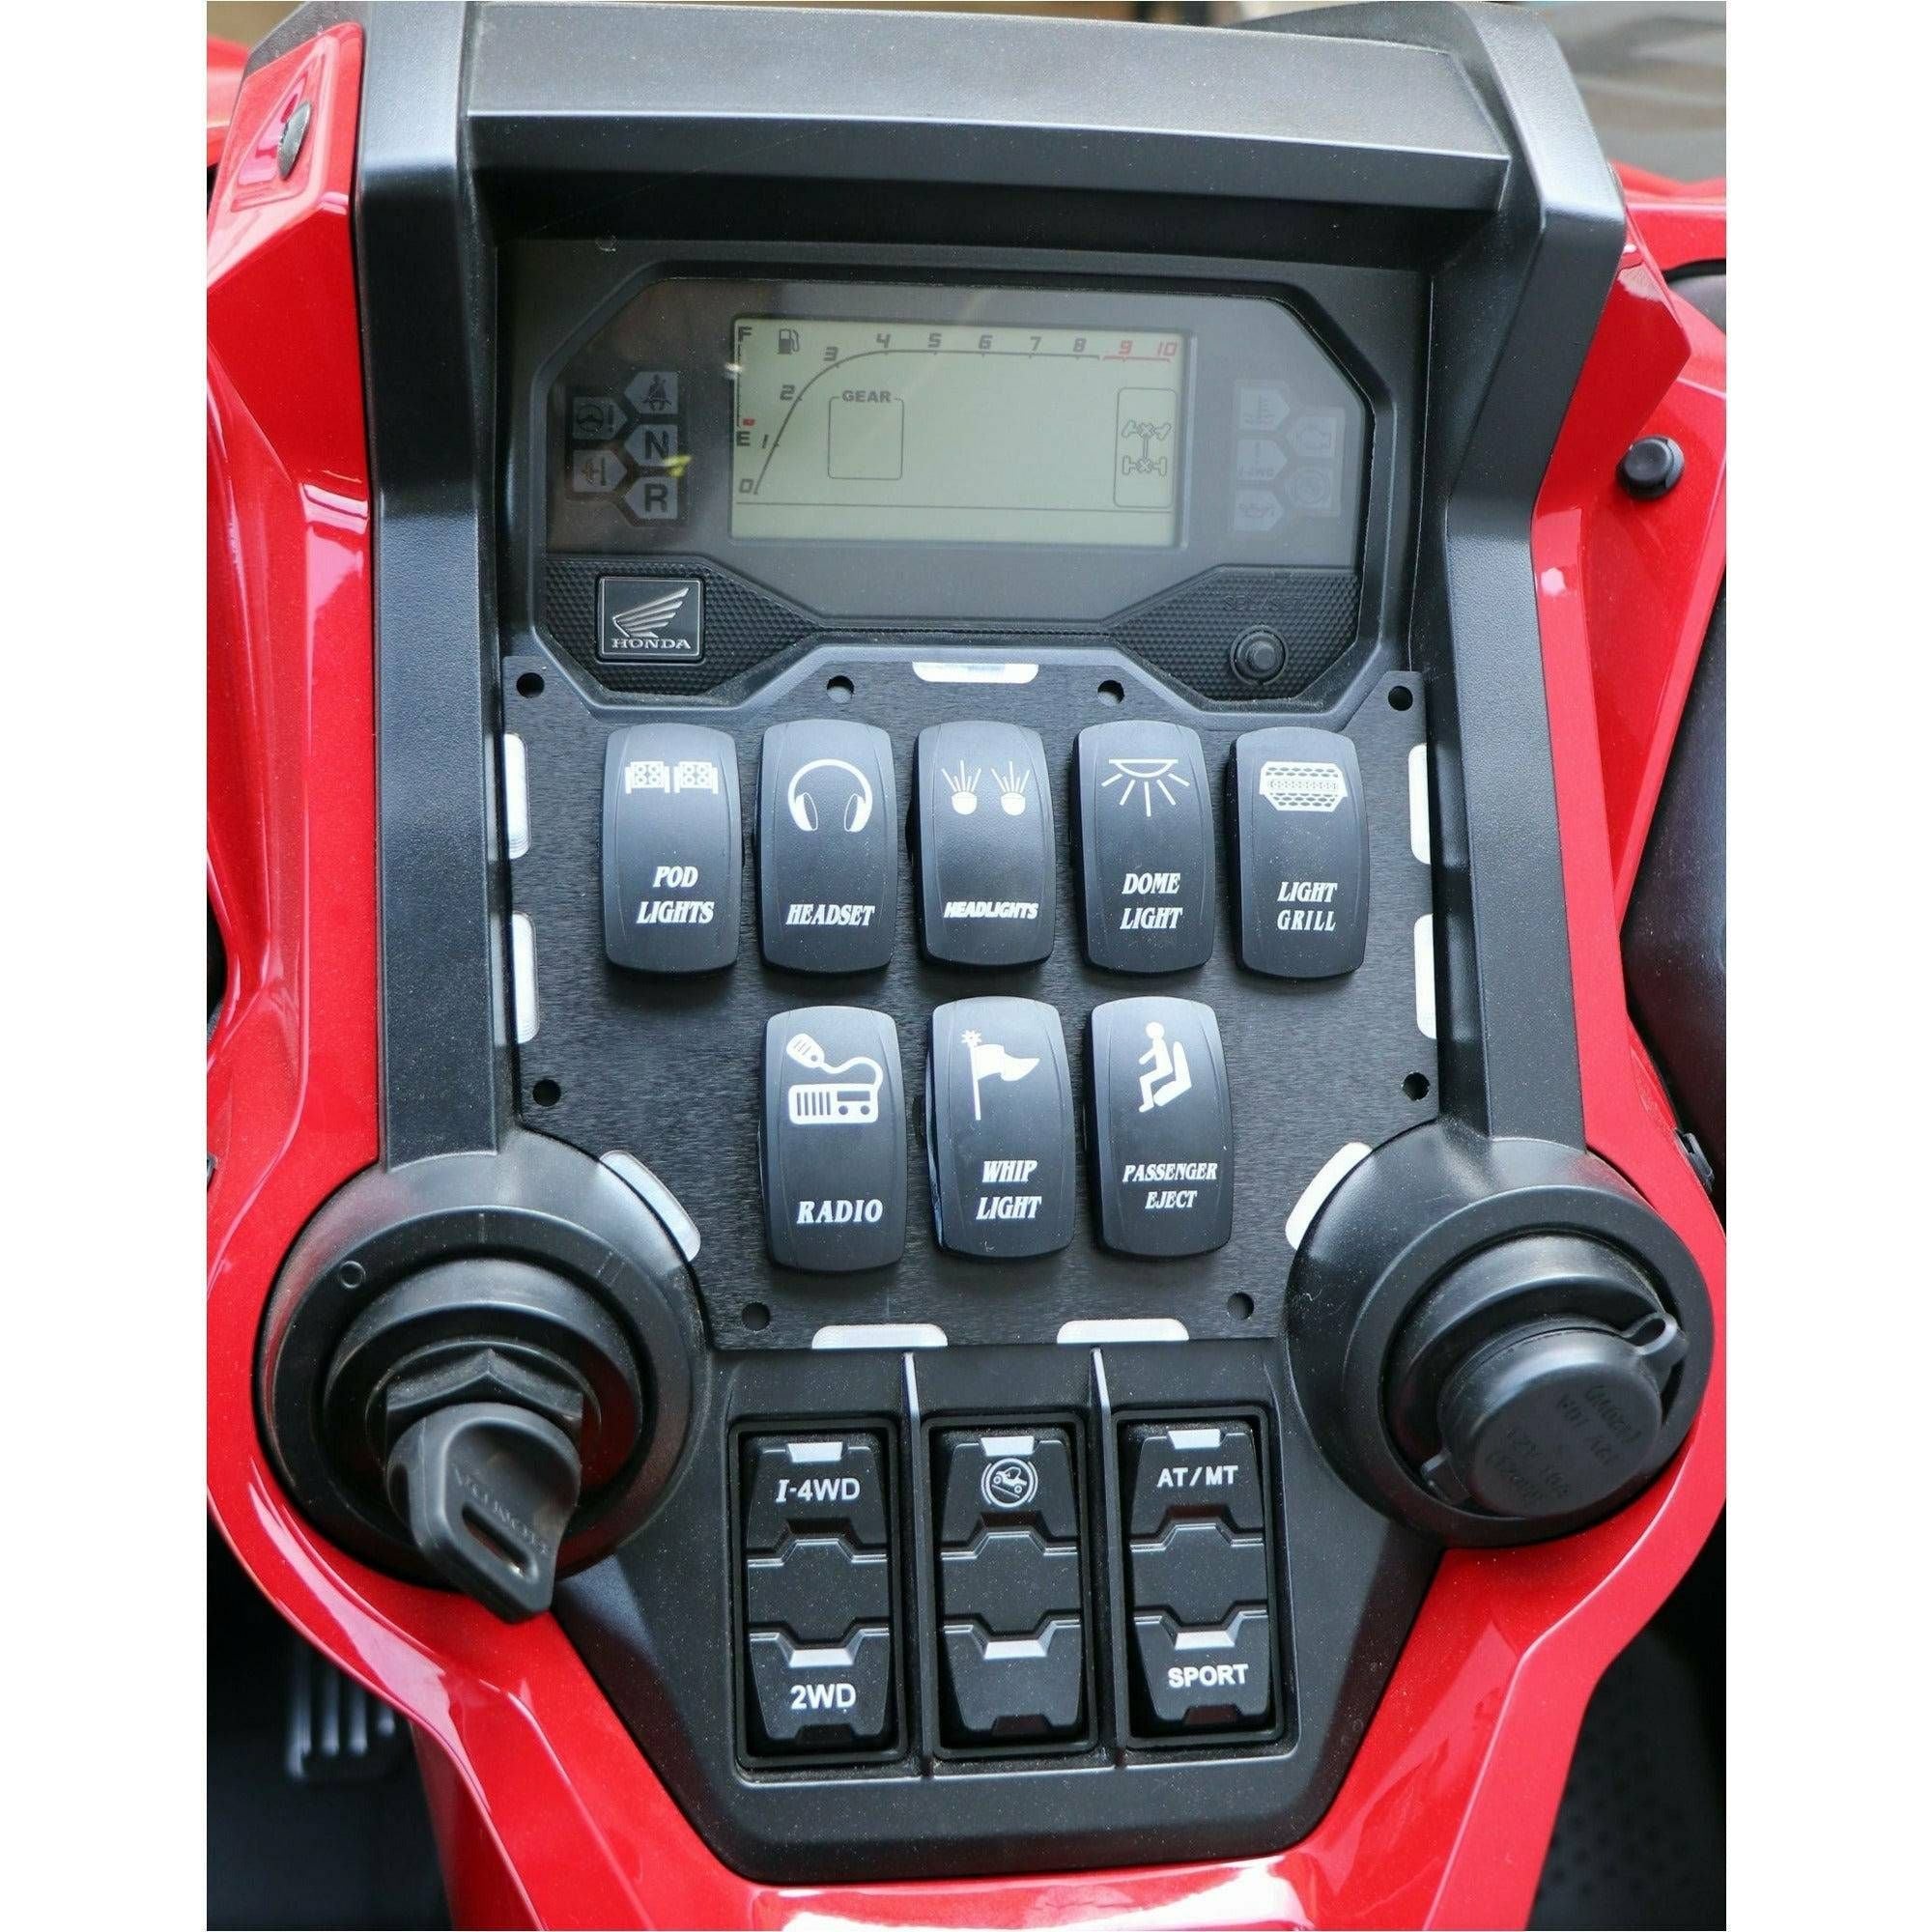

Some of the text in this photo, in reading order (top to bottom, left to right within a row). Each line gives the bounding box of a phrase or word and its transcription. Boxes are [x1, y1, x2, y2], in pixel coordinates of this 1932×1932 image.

[737, 327, 752, 342] F
[875, 333, 891, 349] 4
[928, 332, 943, 349] 5
[979, 334, 993, 351] 6
[1030, 336, 1041, 352] 7
[823, 346, 838, 362] 3
[1073, 337, 1087, 354] 8
[1119, 341, 1133, 356] 9
[1157, 341, 1178, 357] 10
[780, 384, 795, 401] 2
[841, 390, 892, 404] GEAR
[644, 431, 669, 460] N
[737, 431, 751, 447] E
[644, 484, 667, 513] R
[611, 638, 692, 650] HONDA
[653, 866, 697, 888] POD
[1122, 873, 1180, 895] DOME
[1277, 882, 1338, 902] LIGHT
[637, 901, 714, 923] LIGHTS
[785, 904, 875, 925] HEADSET
[944, 901, 1038, 919] HEADLIGHTS
[1120, 907, 1182, 929] LIGHT
[1278, 910, 1336, 931] GRILL
[982, 1160, 1037, 1182] WHIP
[1122, 1163, 1217, 1182] PASSENGER
[976, 1196, 1041, 1219] LIGHT
[1145, 1190, 1197, 1208] EJECT
[797, 1199, 883, 1224] RADIO
[776, 1478, 860, 1502] I-4WD
[1168, 1663, 1248, 1688] SPORT
[791, 1684, 856, 1710] 2WD
